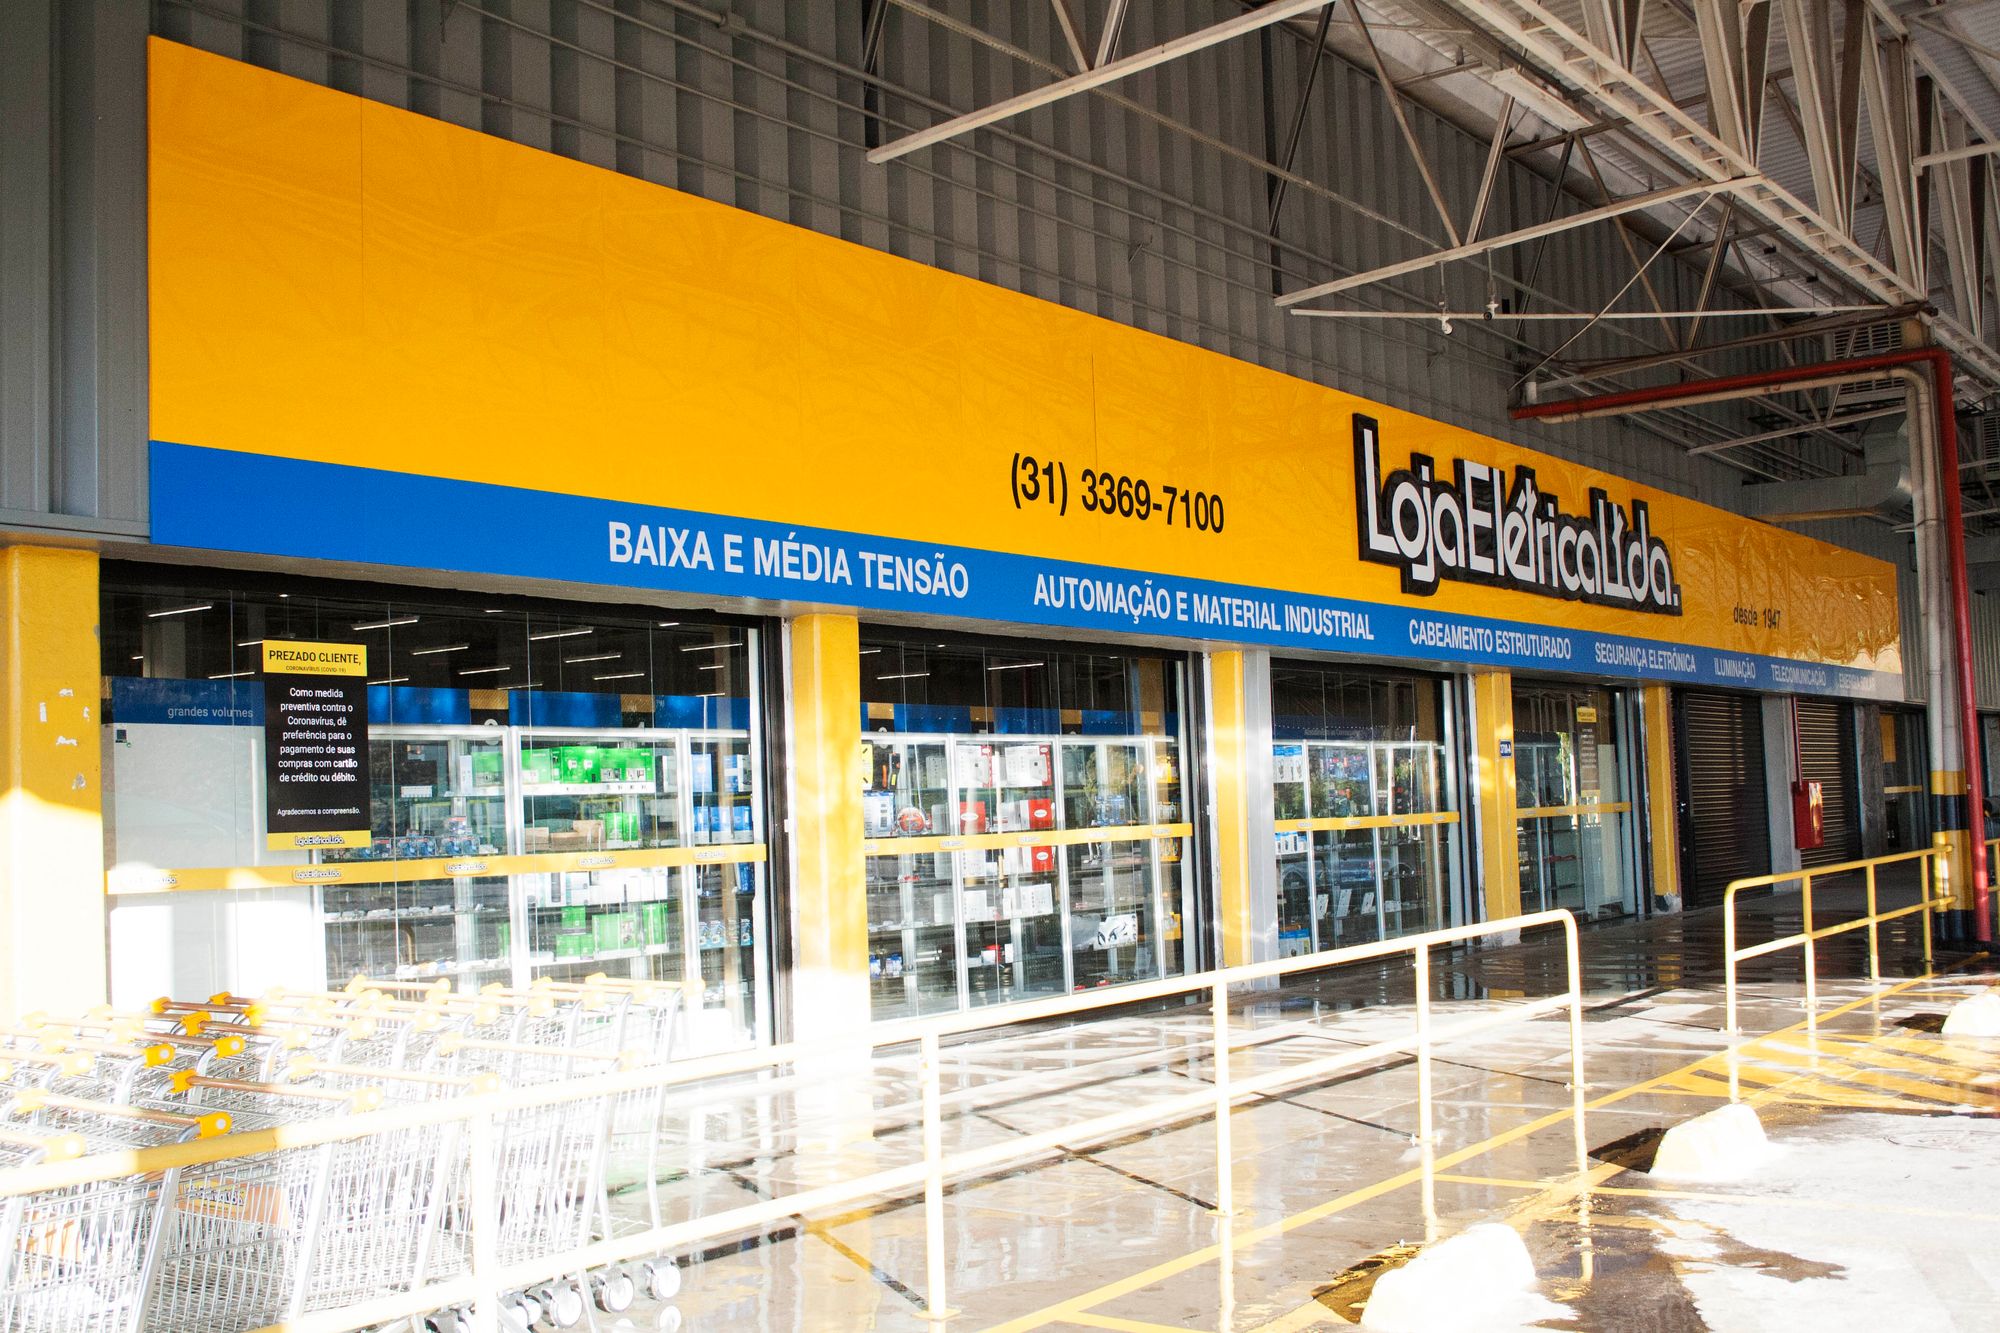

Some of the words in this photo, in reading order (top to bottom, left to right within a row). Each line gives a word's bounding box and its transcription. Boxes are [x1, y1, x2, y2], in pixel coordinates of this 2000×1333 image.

[1011, 452, 1068, 516] (31)
[1081, 468, 1225, 534] 3369-7100
[608, 521, 715, 571] BAIXA
[723, 533, 744, 574] E
[754, 532, 853, 586] MÉDIA
[858, 551, 970, 599] TENSÃO
[1034, 573, 1171, 624] AUTOMAÇÃO
[1176, 591, 1188, 622] E
[1193, 593, 1282, 632] MATERIAL
[1284, 604, 1375, 641] INDUSTRIAL
[1733, 601, 1758, 627] desde
[1762, 606, 1781, 631] 1947
[1409, 619, 1493, 652] CABEAMENTO
[1495, 630, 1572, 661] ESTRUTURADO
[269, 650, 317, 662] PREZADO
[318, 652, 362, 667] CLIENTE,
[1594, 641, 1648, 673] SEGURANÇA
[1649, 647, 1697, 674] ELETRÔNICA
[1714, 656, 1756, 682] ILUMINAÇÃO
[289, 686, 314, 698] Como
[315, 688, 344, 698] medida
[167, 705, 209, 719] grandes
[212, 706, 255, 718] volumes
[280, 702, 321, 713] preventiva
[321, 702, 347, 713] contra
[347, 704, 354, 713] o
[287, 715, 336, 727] Coronavírus,
[337, 716, 347, 727] dê
[282, 730, 327, 741] preferência
[328, 731, 346, 741] para
[346, 732, 352, 741] o
[279, 745, 325, 756] pagamento
[326, 744, 336, 754] de
[336, 746, 356, 755] suas
[278, 759, 313, 770] compras
[314, 759, 332, 769] com
[333, 758, 359, 769] cartão
[279, 773, 290, 783] de
[290, 773, 319, 783] crédito
[319, 774, 330, 783] ou
[331, 772, 358, 783] débito.
